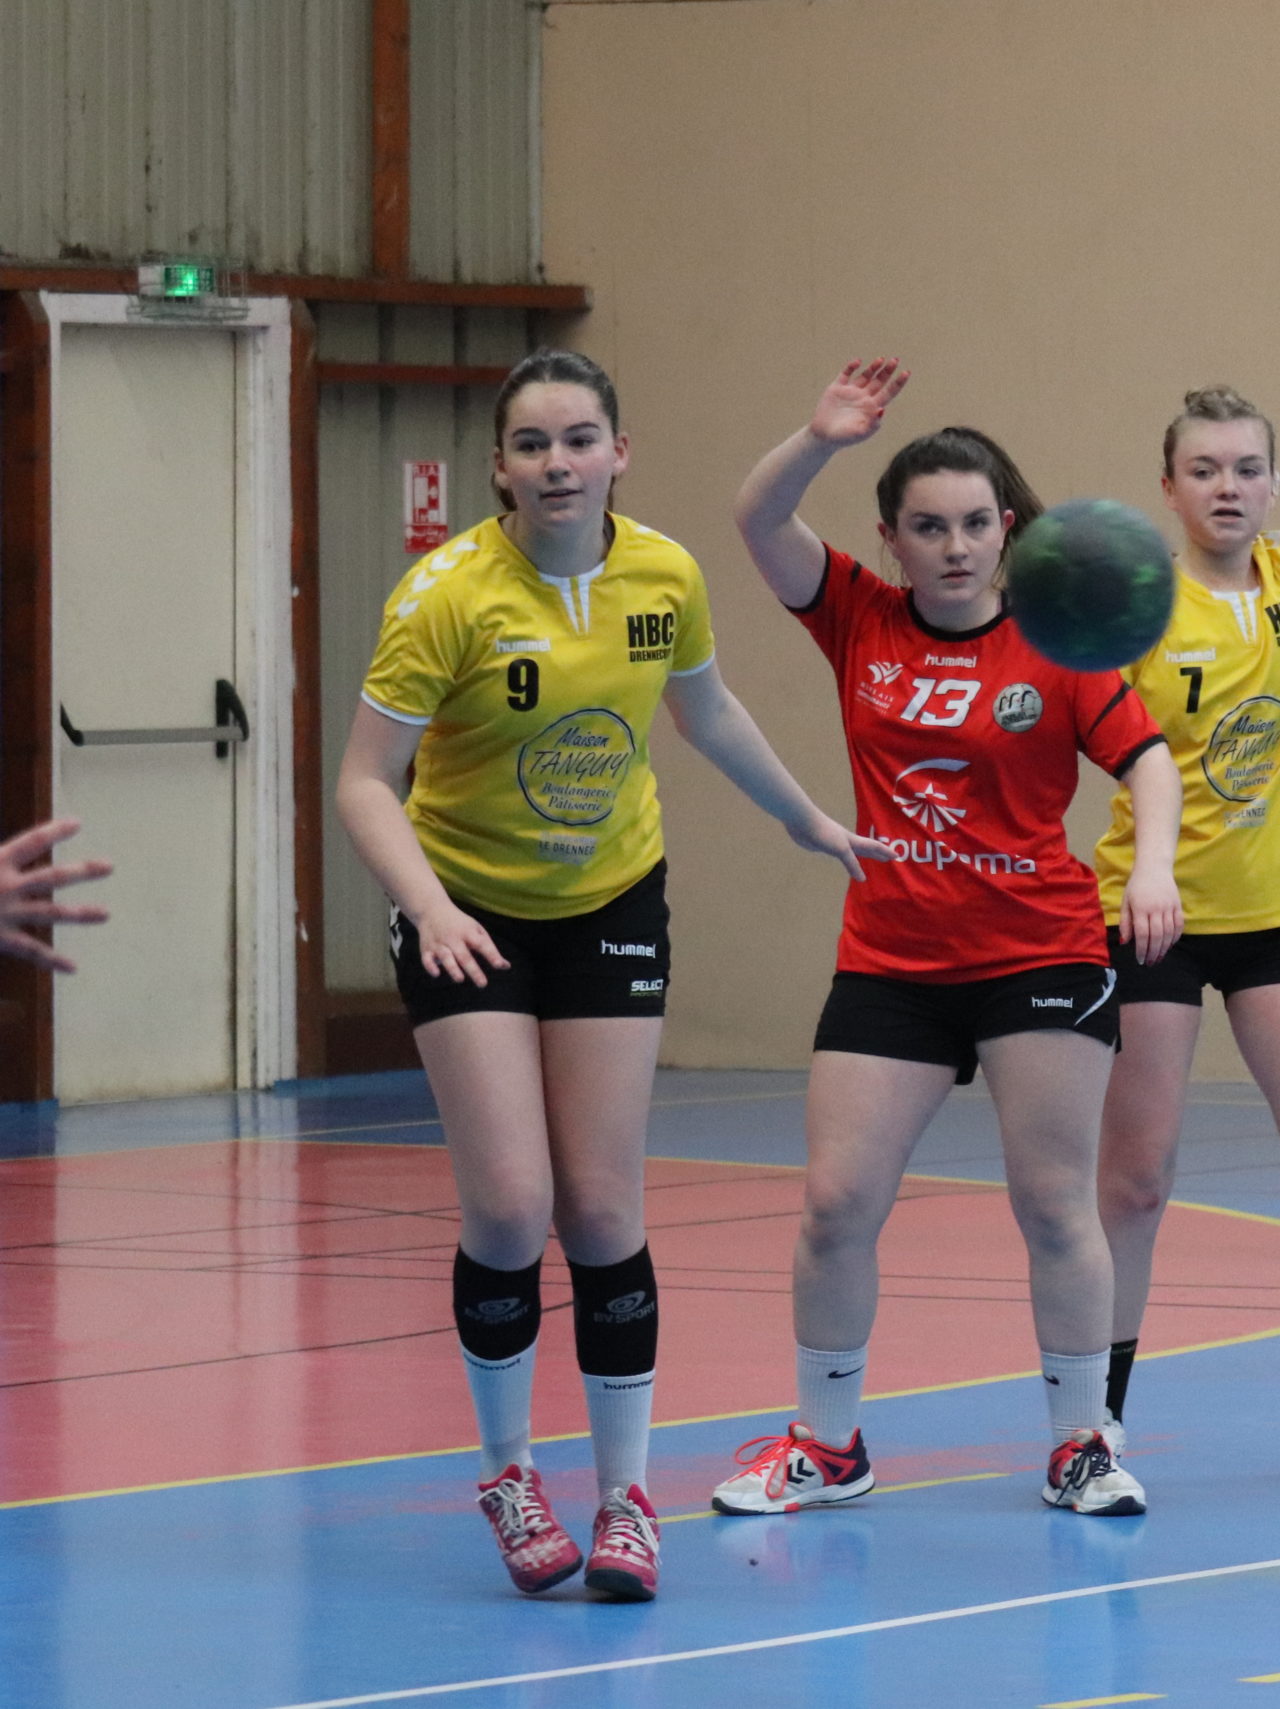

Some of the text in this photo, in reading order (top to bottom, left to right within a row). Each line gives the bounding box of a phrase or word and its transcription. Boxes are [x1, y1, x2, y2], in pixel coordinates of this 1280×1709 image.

[626, 611, 674, 648] HBC
[495, 637, 551, 653] hummel
[924, 653, 978, 669] hummel
[507, 658, 539, 712] 9
[1179, 666, 1203, 713] 7
[900, 677, 983, 728] 13
[554, 726, 610, 748] Maison
[529, 751, 630, 783] TANGUY
[541, 781, 612, 798] Boulangerie
[553, 842, 596, 856] DRENNEC
[601, 939, 656, 959] hummel
[631, 978, 664, 992] SELECT
[1031, 996, 1073, 1009] hummel
